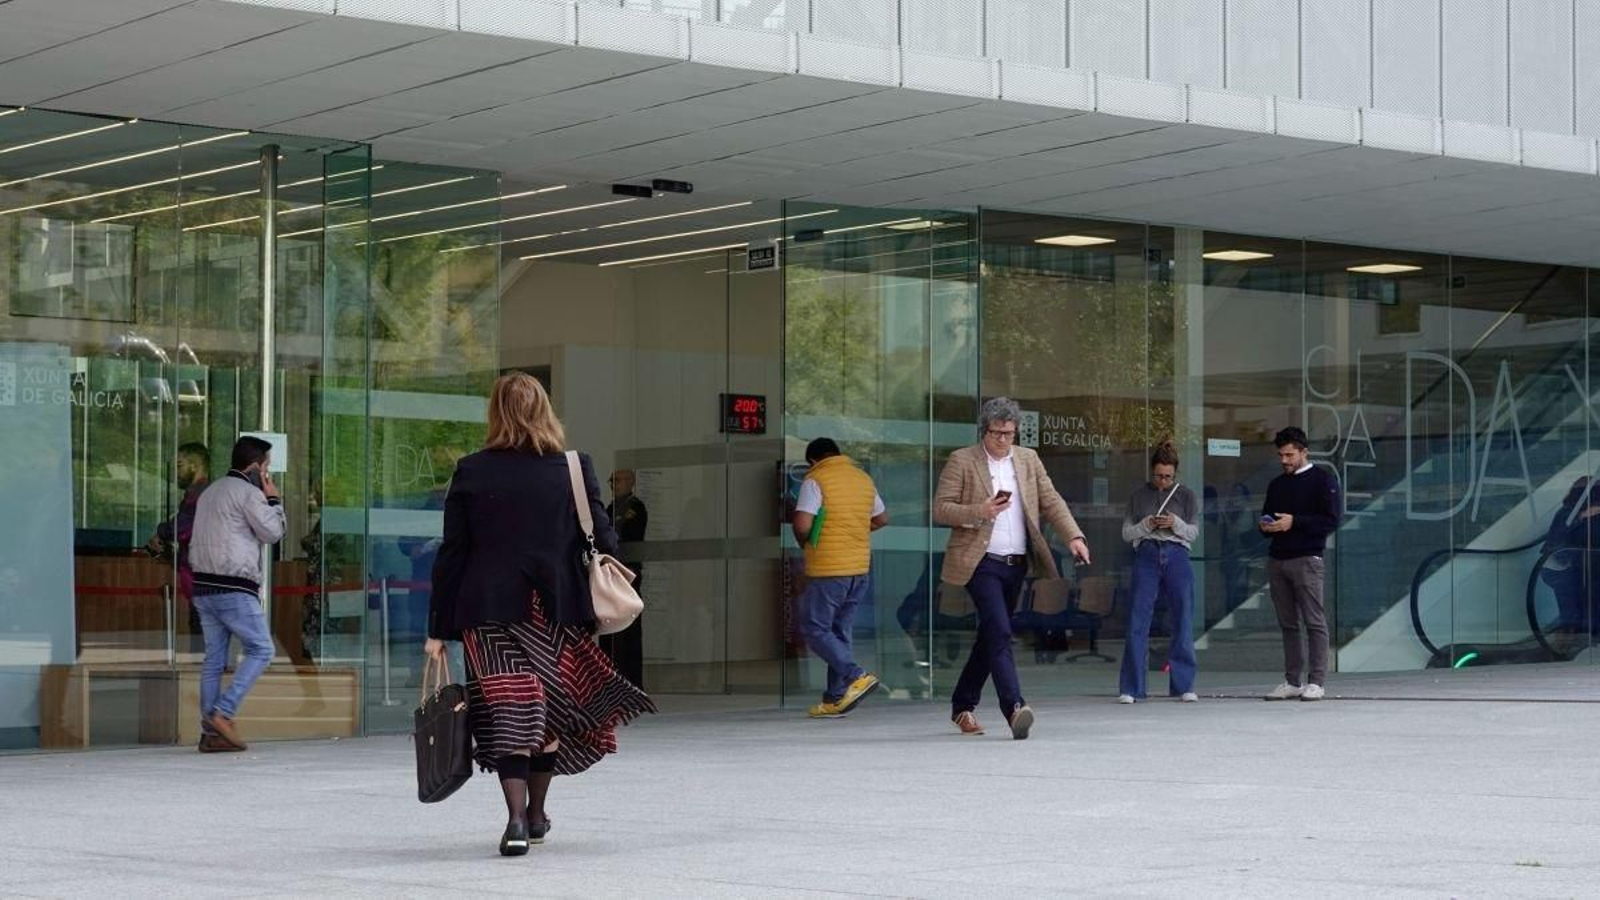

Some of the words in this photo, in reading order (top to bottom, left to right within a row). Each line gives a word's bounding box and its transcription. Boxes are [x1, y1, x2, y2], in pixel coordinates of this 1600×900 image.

[23, 367, 86, 386] XUNTA
[1305, 344, 1362, 399] CI
[22, 387, 46, 404] DE
[52, 388, 124, 408] GALICIA
[1043, 415, 1087, 430] XUNTA
[1305, 402, 1377, 460] DA
[1406, 350, 1538, 523] DA
[1043, 431, 1062, 446] DE
[1062, 432, 1113, 449] GALICIA
[395, 444, 436, 488] DA
